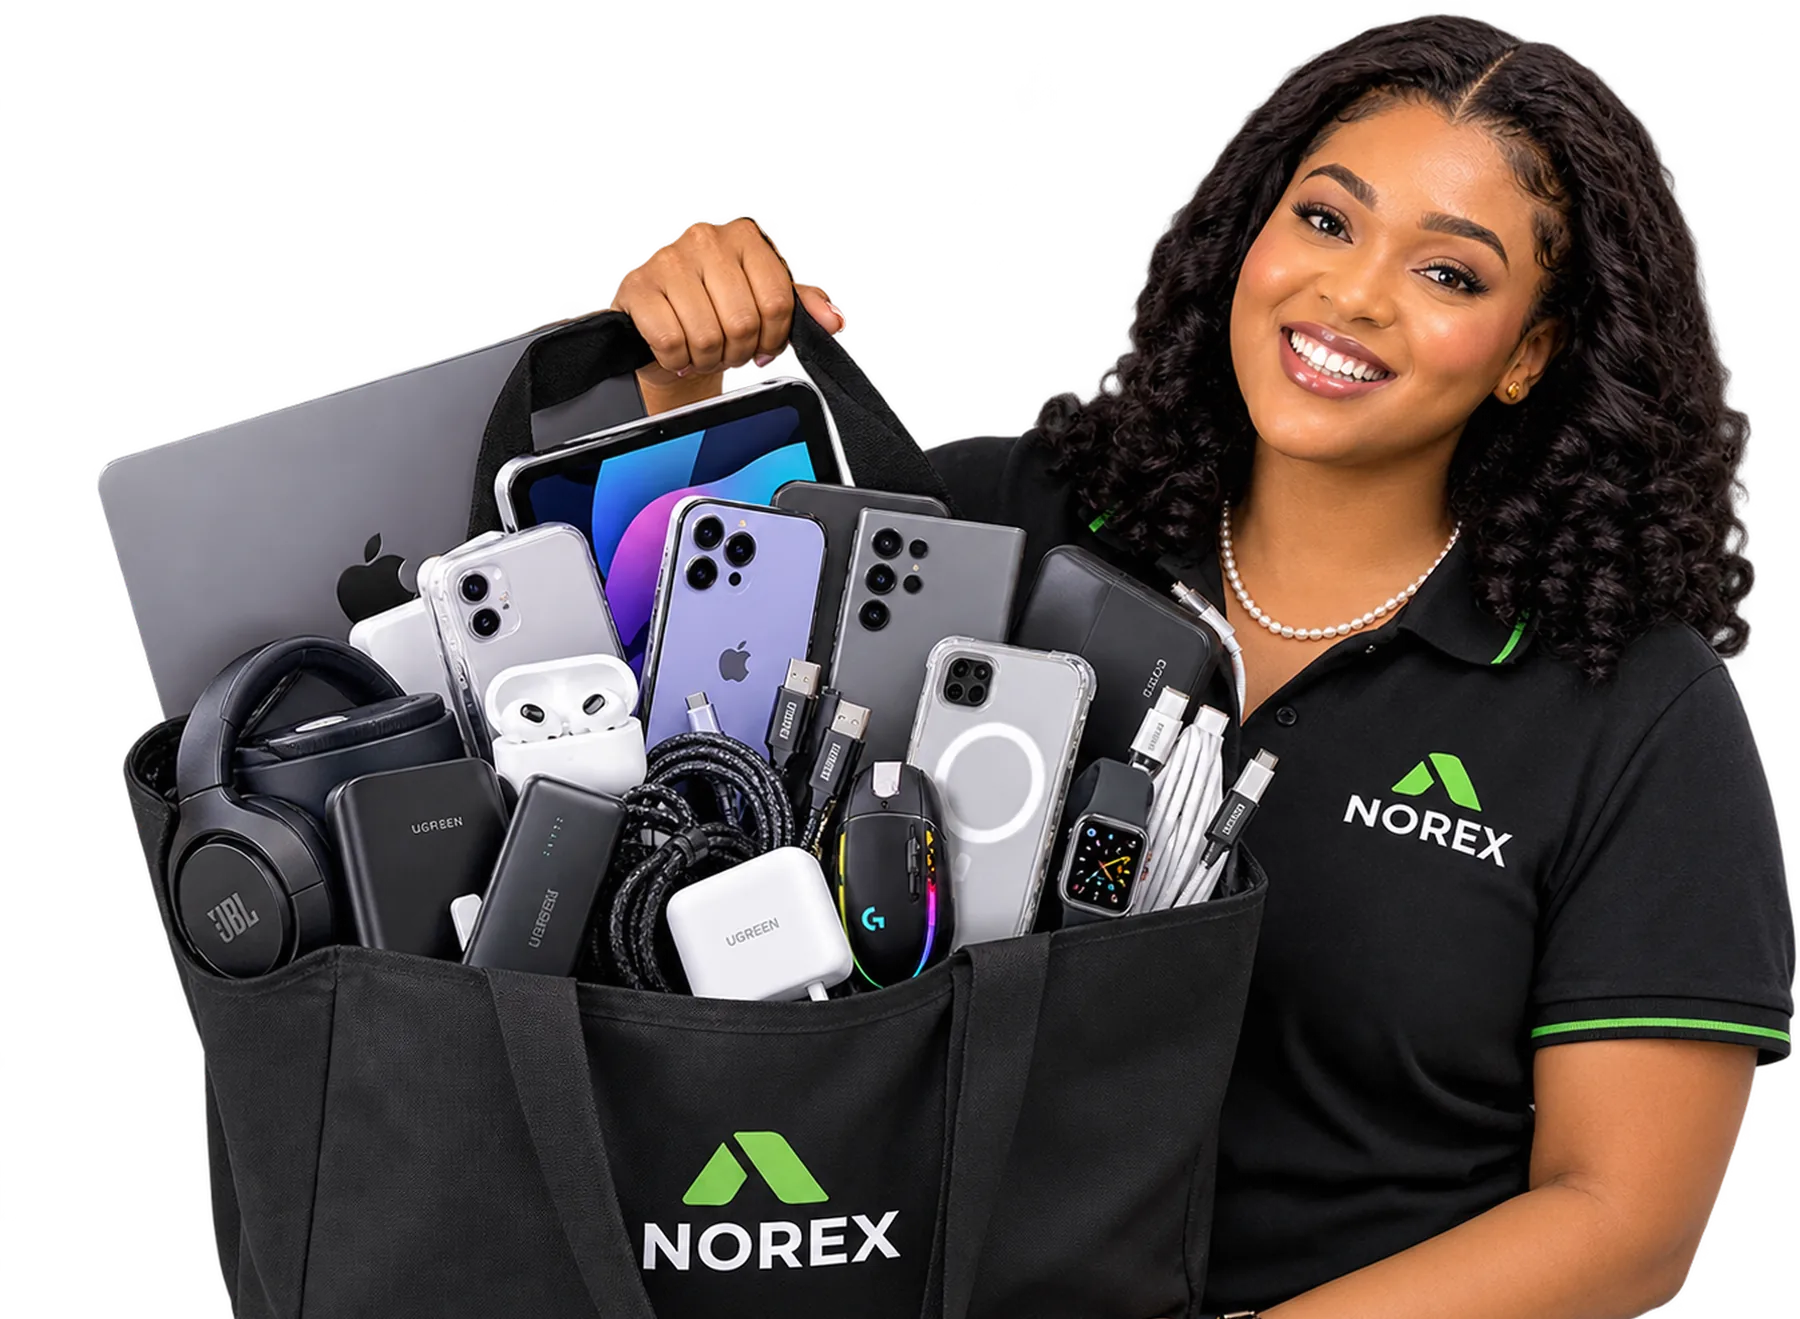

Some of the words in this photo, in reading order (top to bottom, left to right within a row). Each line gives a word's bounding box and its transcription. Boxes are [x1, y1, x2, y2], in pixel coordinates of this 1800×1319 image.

[411, 816, 463, 834] UGREEN
[1343, 794, 1513, 868] NOREX
[206, 892, 260, 943] JBL
[725, 917, 779, 947] UGREEN
[643, 1210, 900, 1271] NOREX
